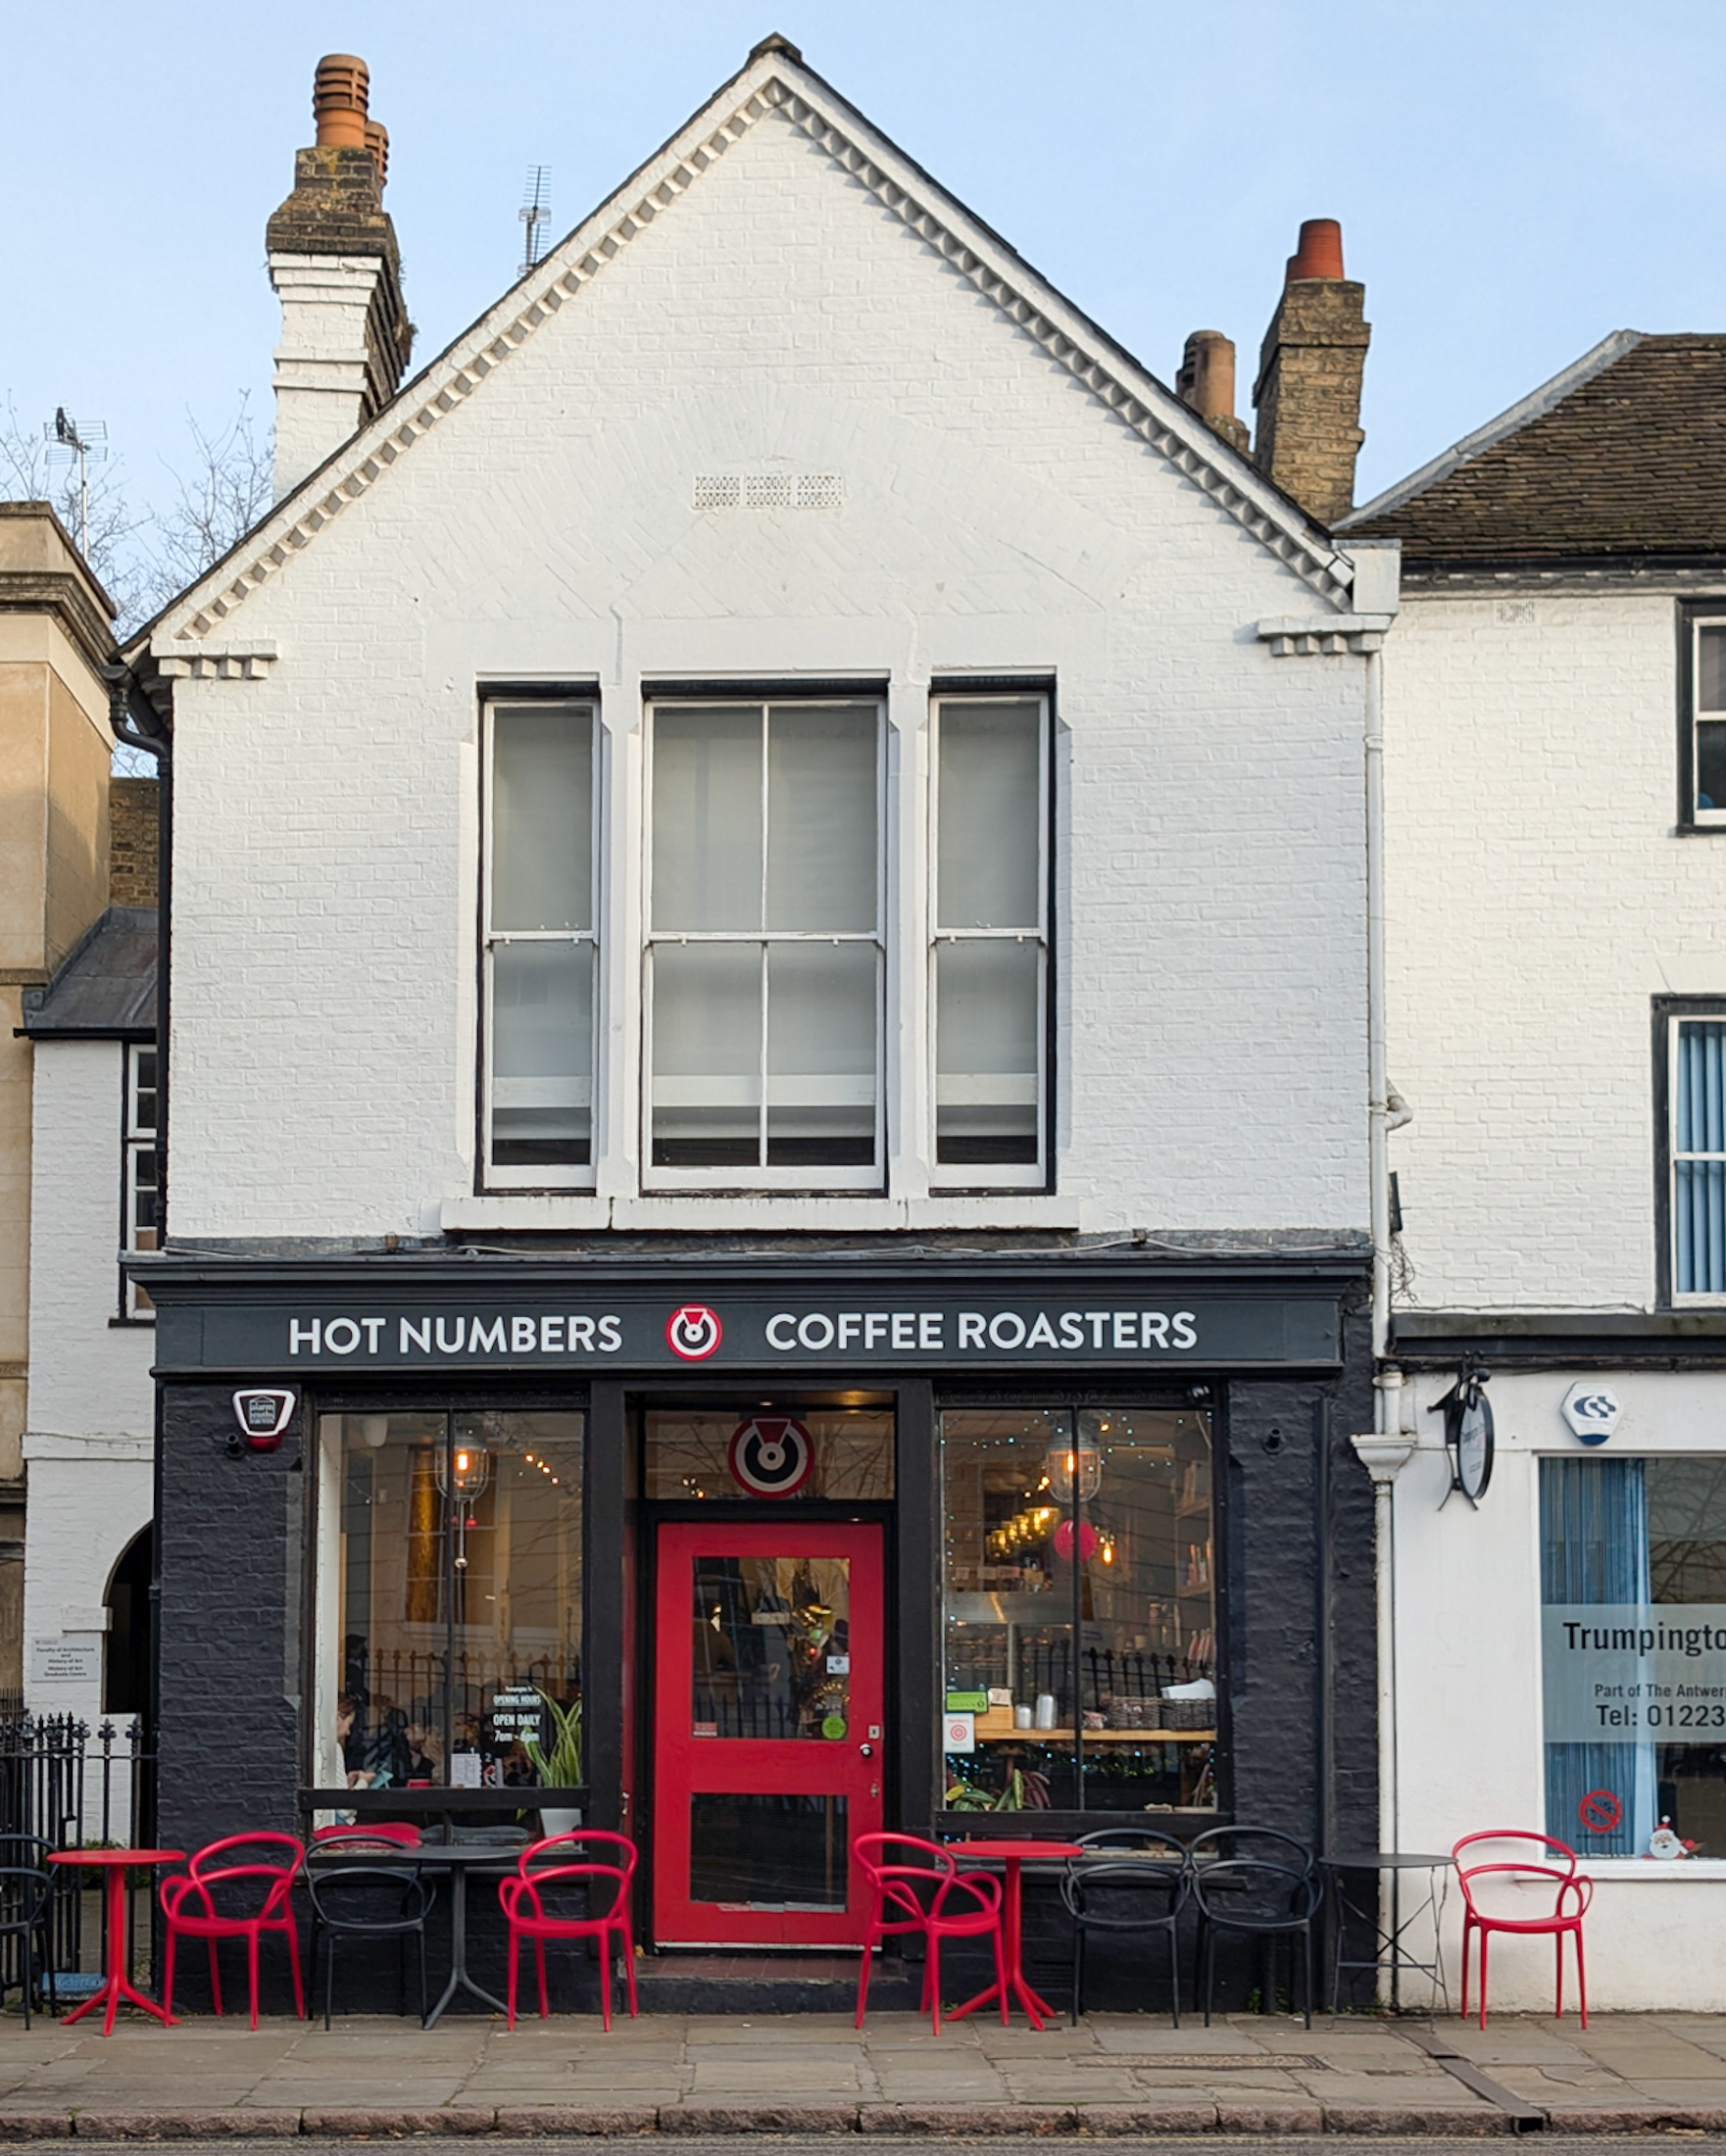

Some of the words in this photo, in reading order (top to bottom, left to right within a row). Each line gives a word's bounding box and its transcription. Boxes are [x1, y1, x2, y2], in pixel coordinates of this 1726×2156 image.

[289, 1317, 386, 1355] HOT
[399, 1315, 622, 1354] NUMBERS
[764, 1312, 944, 1350] COFFEE
[958, 1311, 1198, 1349] ROASTERS
[1562, 1621, 1726, 1657] Trumpingto
[493, 1694, 519, 1704] OPENING
[520, 1694, 541, 1704] HOURS
[1595, 1684, 1624, 1697] Part
[1628, 1684, 1642, 1697] of
[1646, 1684, 1671, 1697] The
[1676, 1684, 1726, 1698] Antwer
[493, 1713, 516, 1726] OPEN
[517, 1713, 541, 1726] DAILY
[1596, 1704, 1638, 1727] Tel:
[1647, 1704, 1726, 1727] 01223
[494, 1730, 513, 1742] 7am
